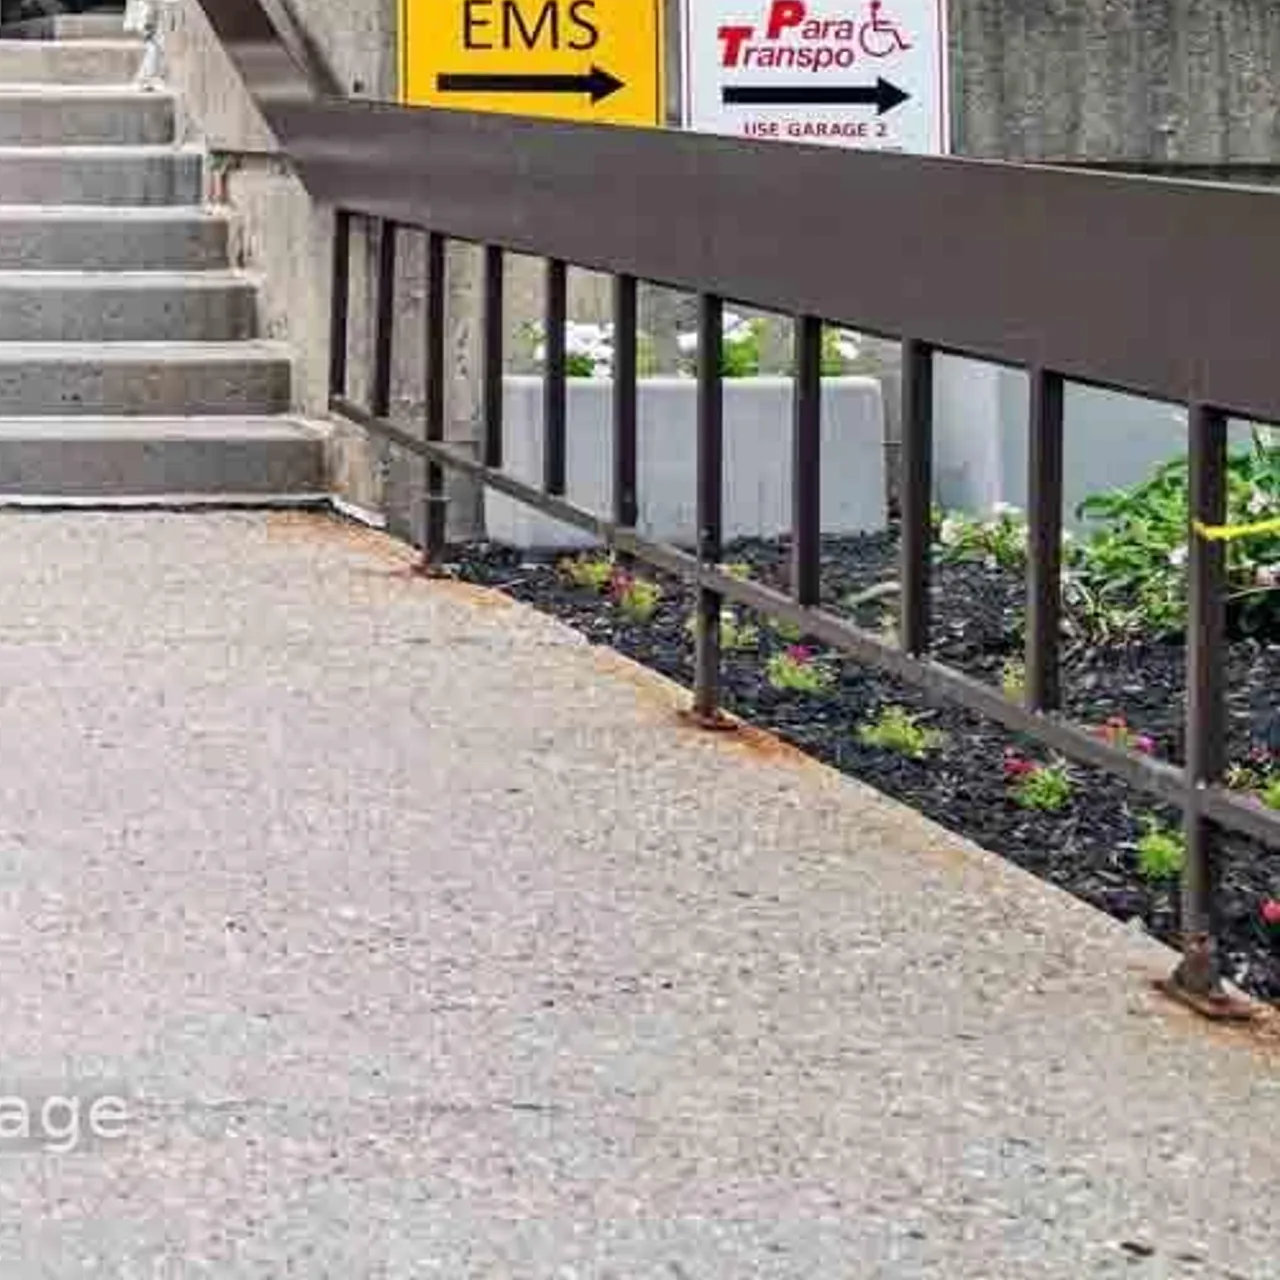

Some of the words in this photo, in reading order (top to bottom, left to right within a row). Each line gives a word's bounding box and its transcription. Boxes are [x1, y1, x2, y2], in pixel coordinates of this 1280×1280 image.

[718, 26, 855, 72] Transpo
[744, 122, 779, 137] USE
[788, 122, 867, 137] GARAGE
[875, 122, 889, 137] 2
